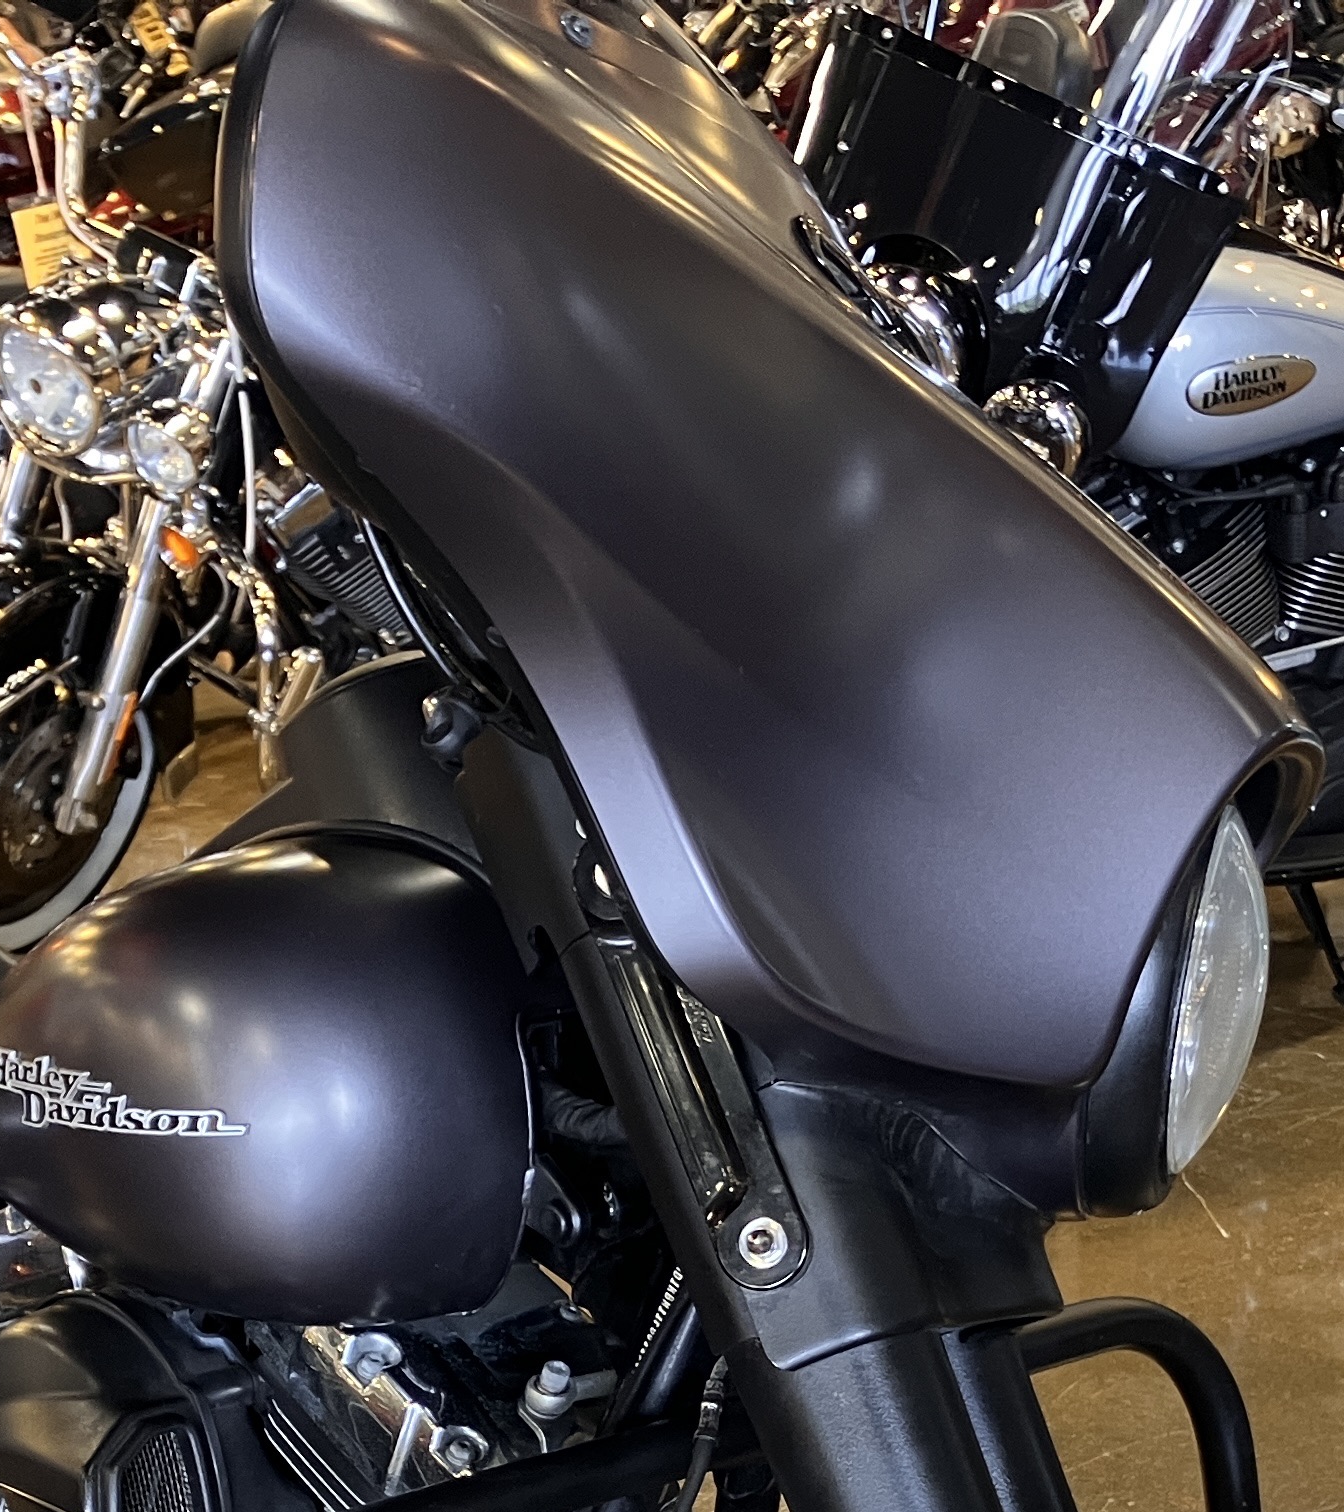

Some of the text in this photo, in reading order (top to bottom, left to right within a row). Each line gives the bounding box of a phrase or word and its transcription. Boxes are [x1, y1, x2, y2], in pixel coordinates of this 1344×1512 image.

[1213, 365, 1279, 391] HARLEY
[1201, 381, 1287, 409] DAVIDSON
[20, 1087, 249, 1136] Davidson
